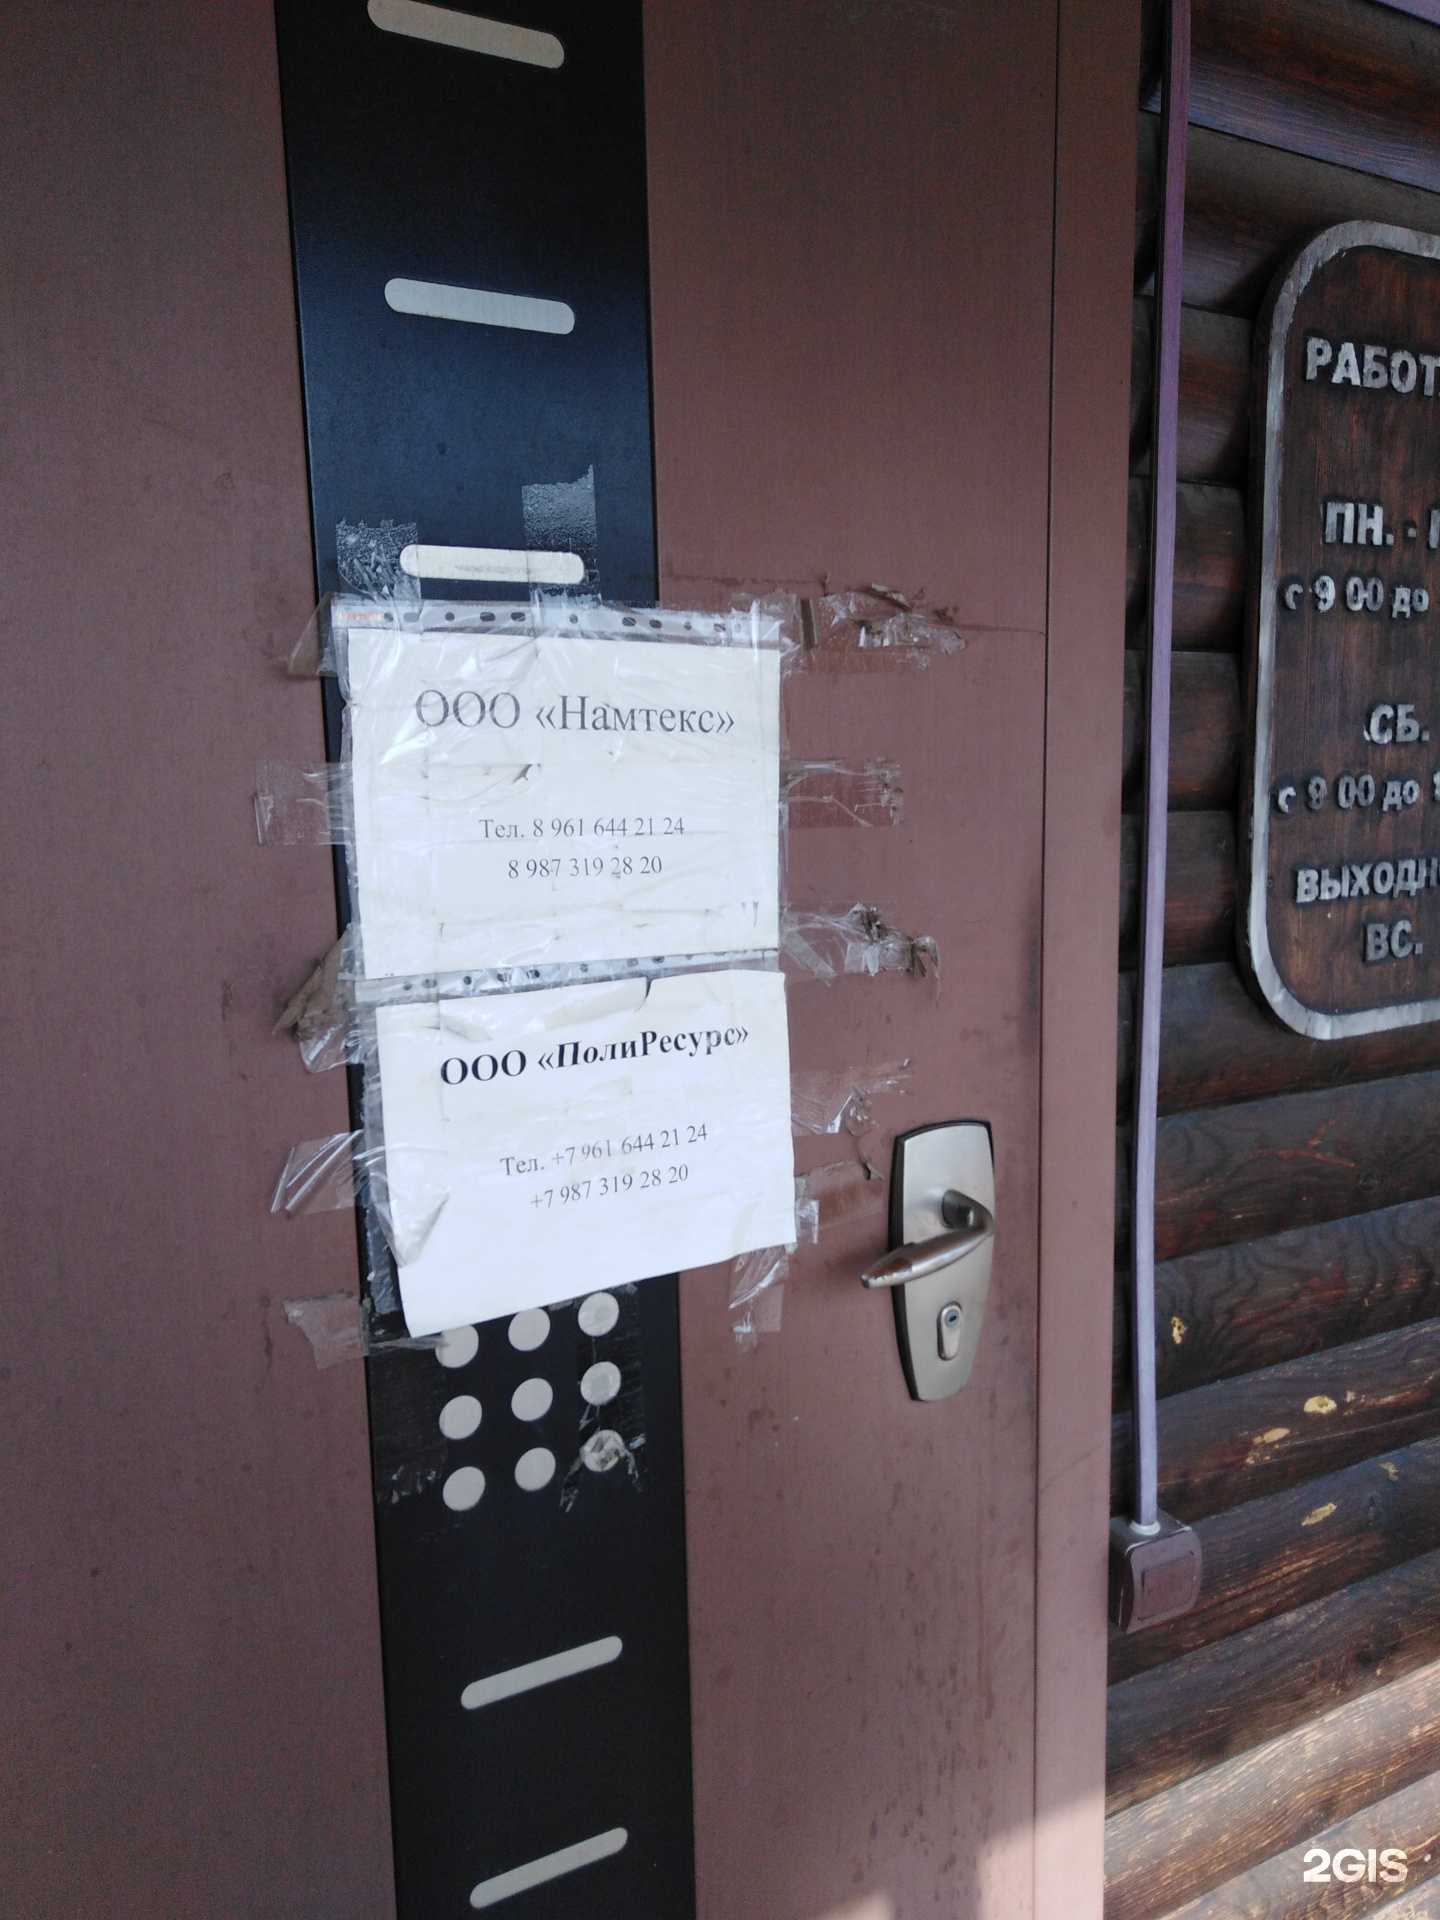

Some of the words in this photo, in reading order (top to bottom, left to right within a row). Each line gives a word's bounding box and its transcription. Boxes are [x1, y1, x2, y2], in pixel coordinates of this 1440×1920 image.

[1325, 502, 1394, 546] ПН.
[1315, 575, 1336, 613] 9
[1346, 576, 1385, 612] 00
[1392, 586, 1430, 619] до
[415, 689, 521, 728] ООО
[535, 695, 735, 734] «Намтекс»
[1369, 704, 1430, 744] СБ.
[1338, 774, 1376, 809] 00
[1383, 780, 1420, 811] до
[478, 818, 525, 839] Тел.
[533, 818, 544, 837] 8
[551, 817, 584, 837] 961
[593, 817, 628, 837] 644
[634, 817, 654, 836] 21
[663, 816, 685, 835] 24
[508, 859, 519, 879] 8
[526, 858, 561, 879] 987
[569, 856, 604, 877] 319
[611, 856, 633, 876] 28
[640, 855, 662, 875] 20
[1367, 919, 1424, 961] ВС.
[440, 1049, 527, 1085] ООО
[537, 1024, 749, 1071] «ПолиРесурс»
[499, 1156, 545, 1176] Тел.
[552, 1147, 576, 1166] +7
[582, 1139, 613, 1160] 961
[621, 1132, 655, 1155] 644
[660, 1128, 680, 1149] 21
[687, 1123, 709, 1143] 24
[530, 1189, 554, 1209] +7
[560, 1180, 592, 1205] 987
[600, 1173, 633, 1196] 319
[640, 1168, 662, 1189] 28
[668, 1163, 689, 1184] 20
